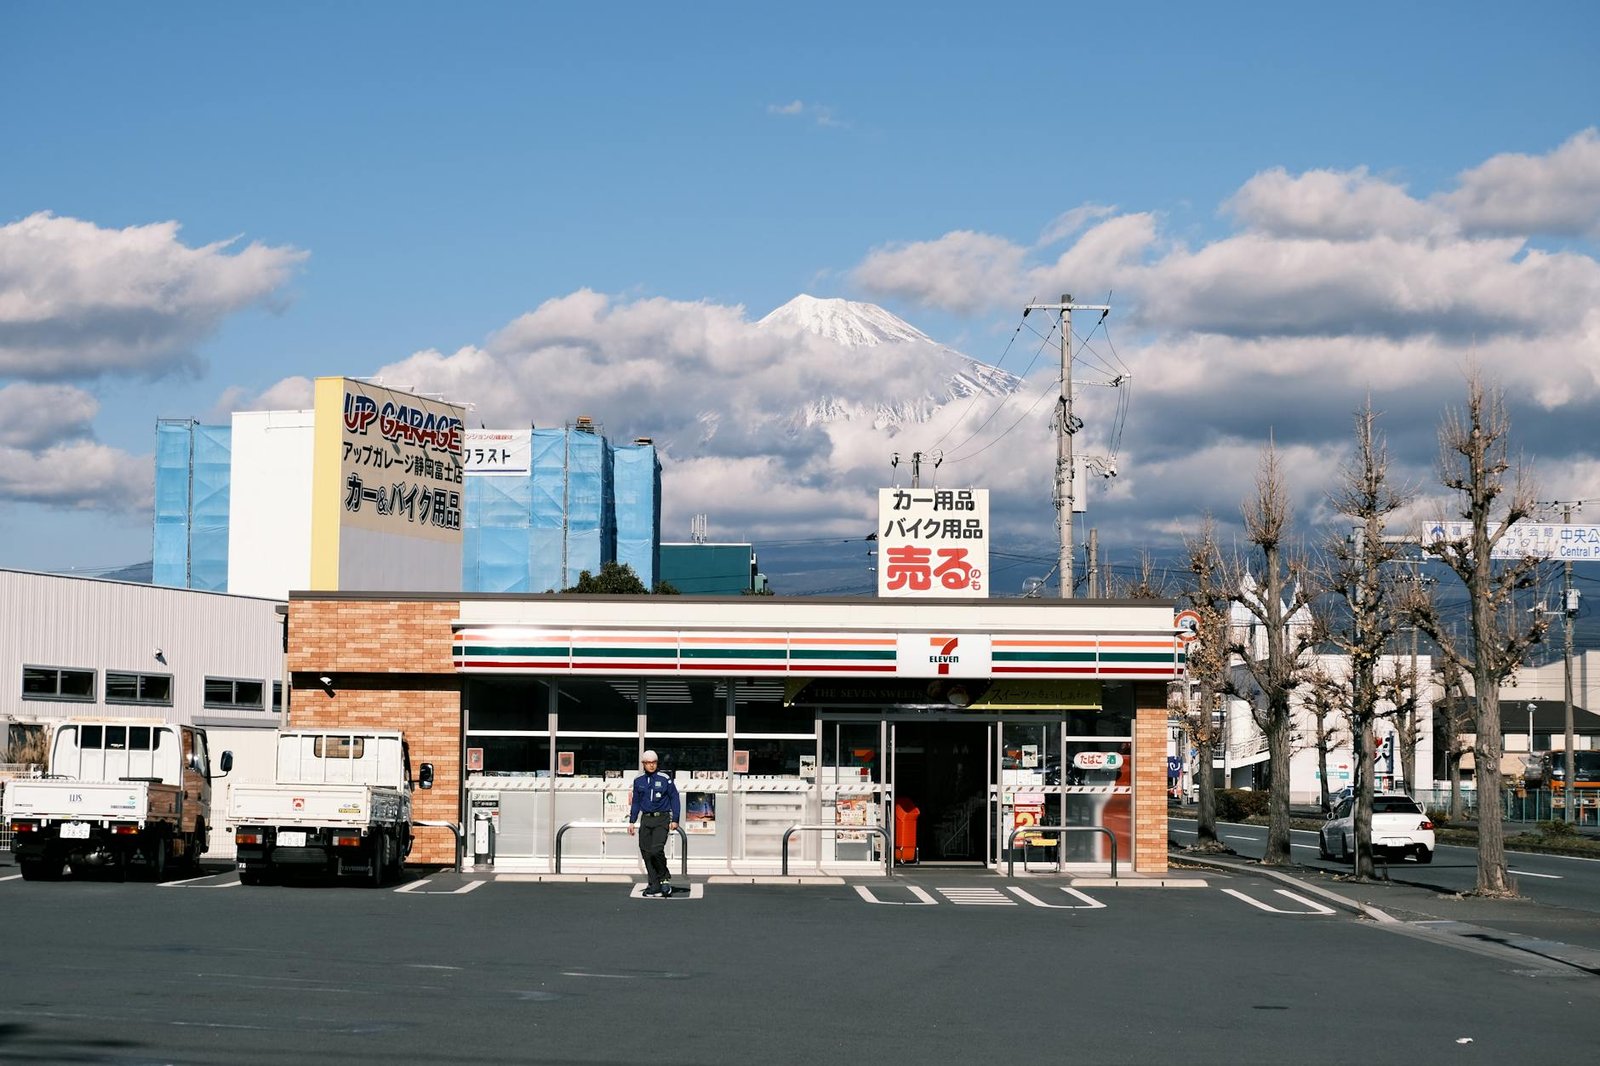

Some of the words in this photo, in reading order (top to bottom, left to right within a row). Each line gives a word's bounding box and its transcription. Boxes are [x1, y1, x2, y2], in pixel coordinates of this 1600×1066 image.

[344, 392, 378, 434] UP
[380, 402, 464, 456] GARAGE
[343, 442, 463, 484] アップガレージ静岡富士店
[345, 472, 461, 530] カー&バイク用品
[893, 490, 975, 511] カー用品
[884, 517, 983, 539] バイク用品
[1560, 546, 1591, 557] Central
[886, 545, 973, 590] 売る
[815, 688, 837, 697] THE
[840, 688, 877, 697] SEVEN
[1080, 754, 1102, 764] たばこ
